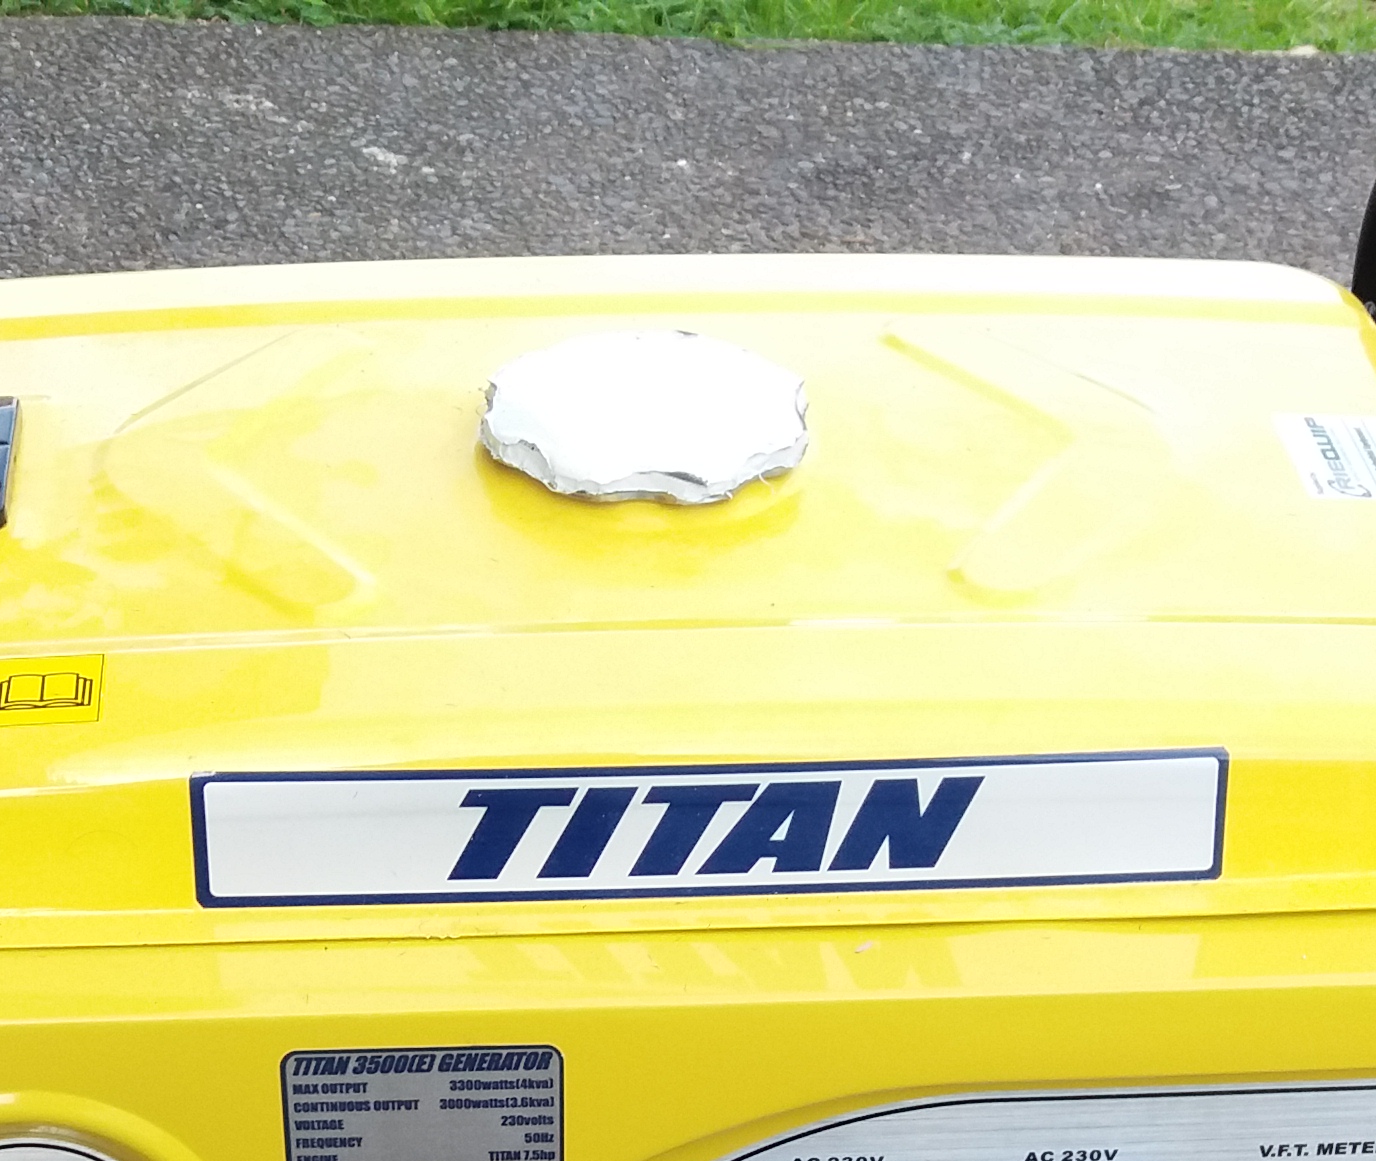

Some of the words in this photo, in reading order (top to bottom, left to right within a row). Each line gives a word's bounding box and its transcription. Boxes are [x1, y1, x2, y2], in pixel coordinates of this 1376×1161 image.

[447, 776, 985, 881] TITAN
[292, 1056, 348, 1076] TITAN
[353, 1053, 437, 1075] 3500(E)
[438, 1051, 554, 1072] GENERATOR
[293, 1083, 319, 1094] MAX
[321, 1082, 368, 1093] OUTPUT
[293, 1101, 371, 1113] CONTINUOUS
[373, 1100, 420, 1112] OUTPUT
[294, 1120, 344, 1131] VOLTAGE
[501, 1115, 554, 1127] 230volts
[296, 1137, 363, 1149] FREQUENCY
[524, 1132, 555, 1144] 50Hz
[488, 1151, 521, 1161] TITAN
[1259, 1143, 1309, 1158] V.F.T.
